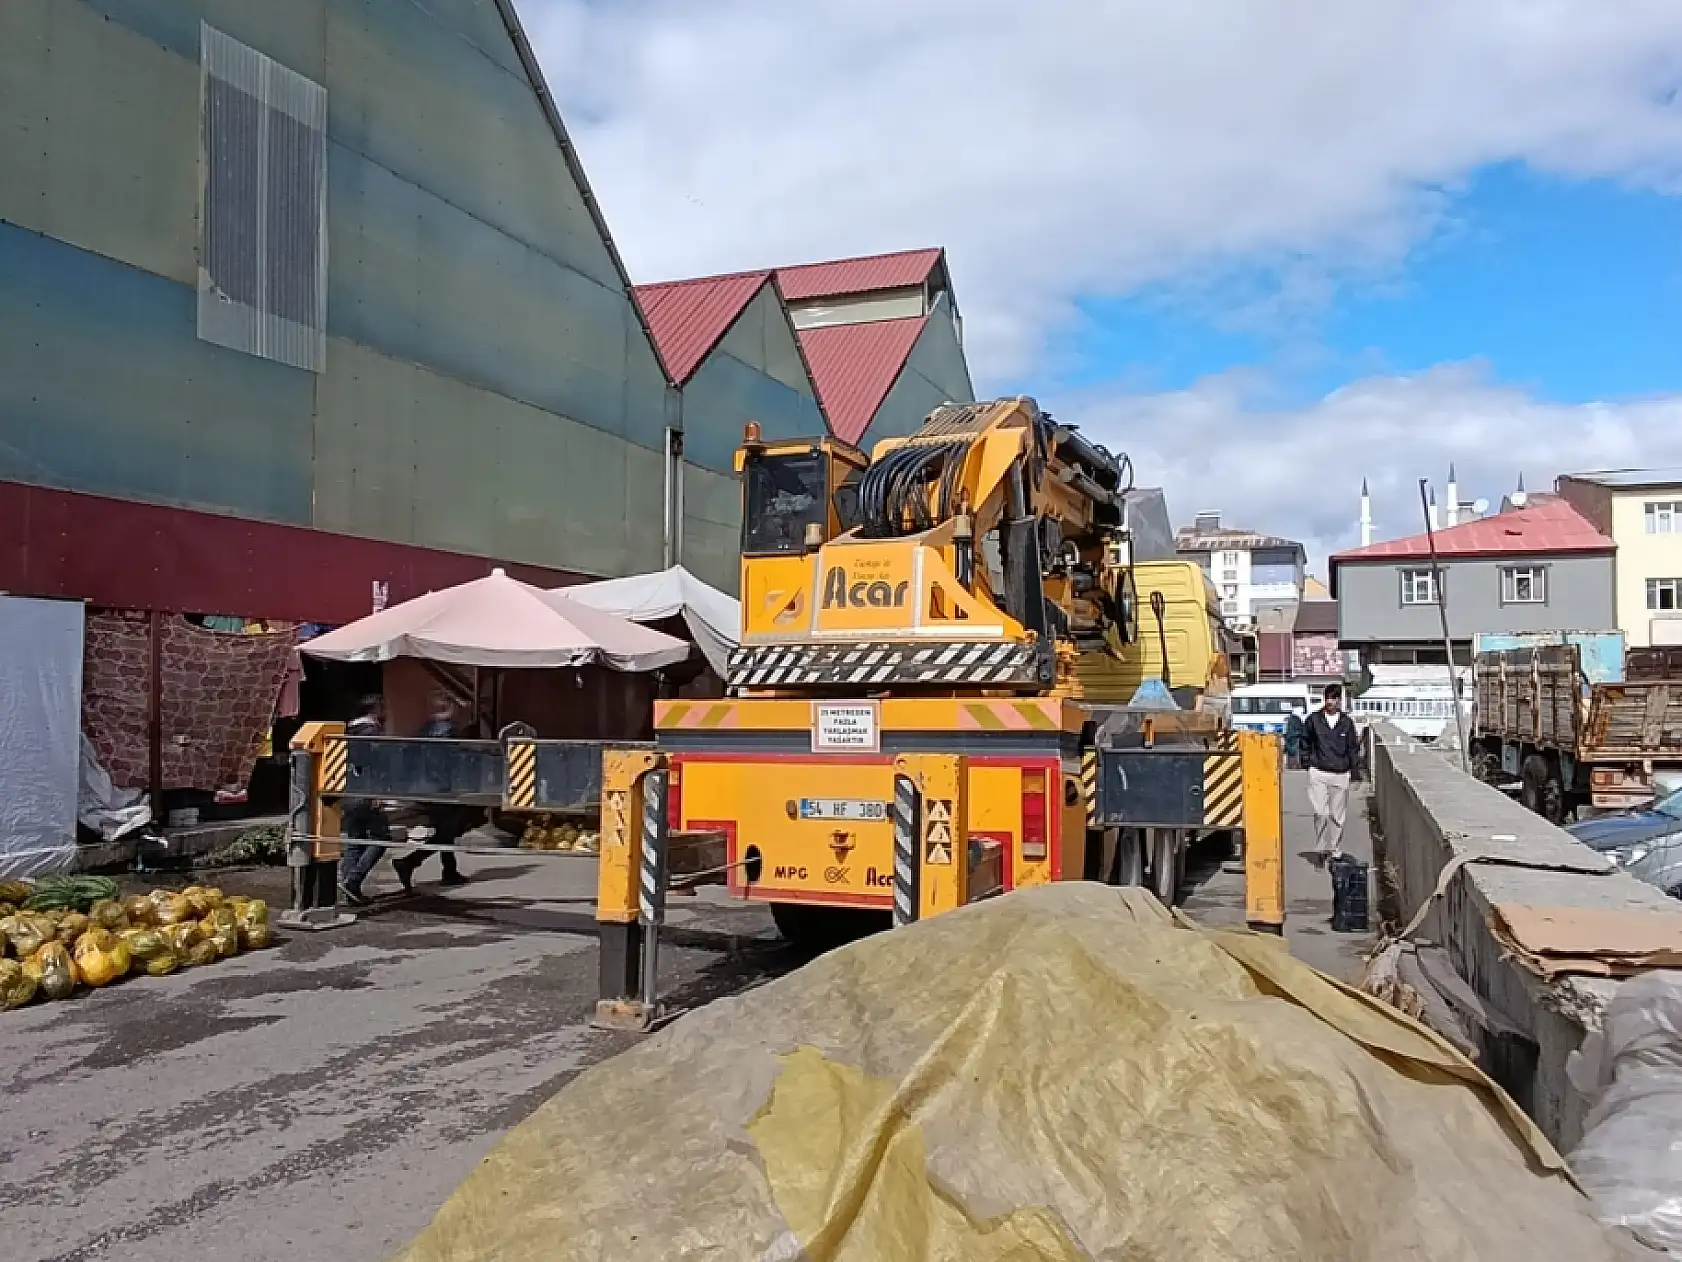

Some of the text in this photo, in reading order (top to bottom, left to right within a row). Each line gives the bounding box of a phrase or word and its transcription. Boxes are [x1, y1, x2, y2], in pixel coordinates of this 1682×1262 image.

[820, 566, 909, 610] Acar
[809, 801, 824, 816] 54
[833, 801, 848, 816] HF
[774, 865, 809, 880] MPG
